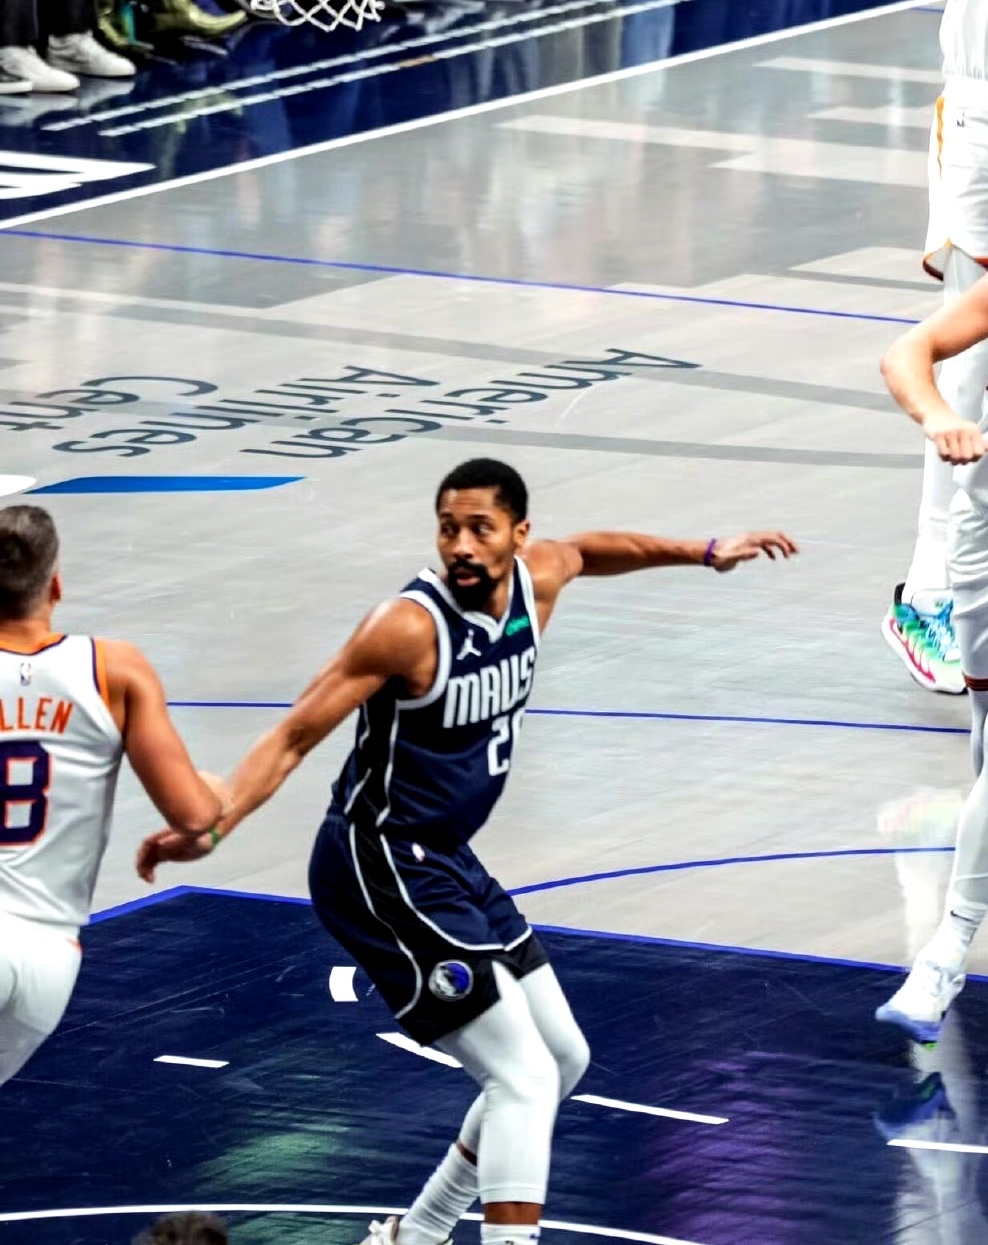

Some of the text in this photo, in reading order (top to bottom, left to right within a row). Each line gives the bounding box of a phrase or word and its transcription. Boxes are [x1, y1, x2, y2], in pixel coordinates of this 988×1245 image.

[52, 366, 440, 458] Airlines
[239, 348, 701, 458] American
[443, 646, 535, 729] MAVS
